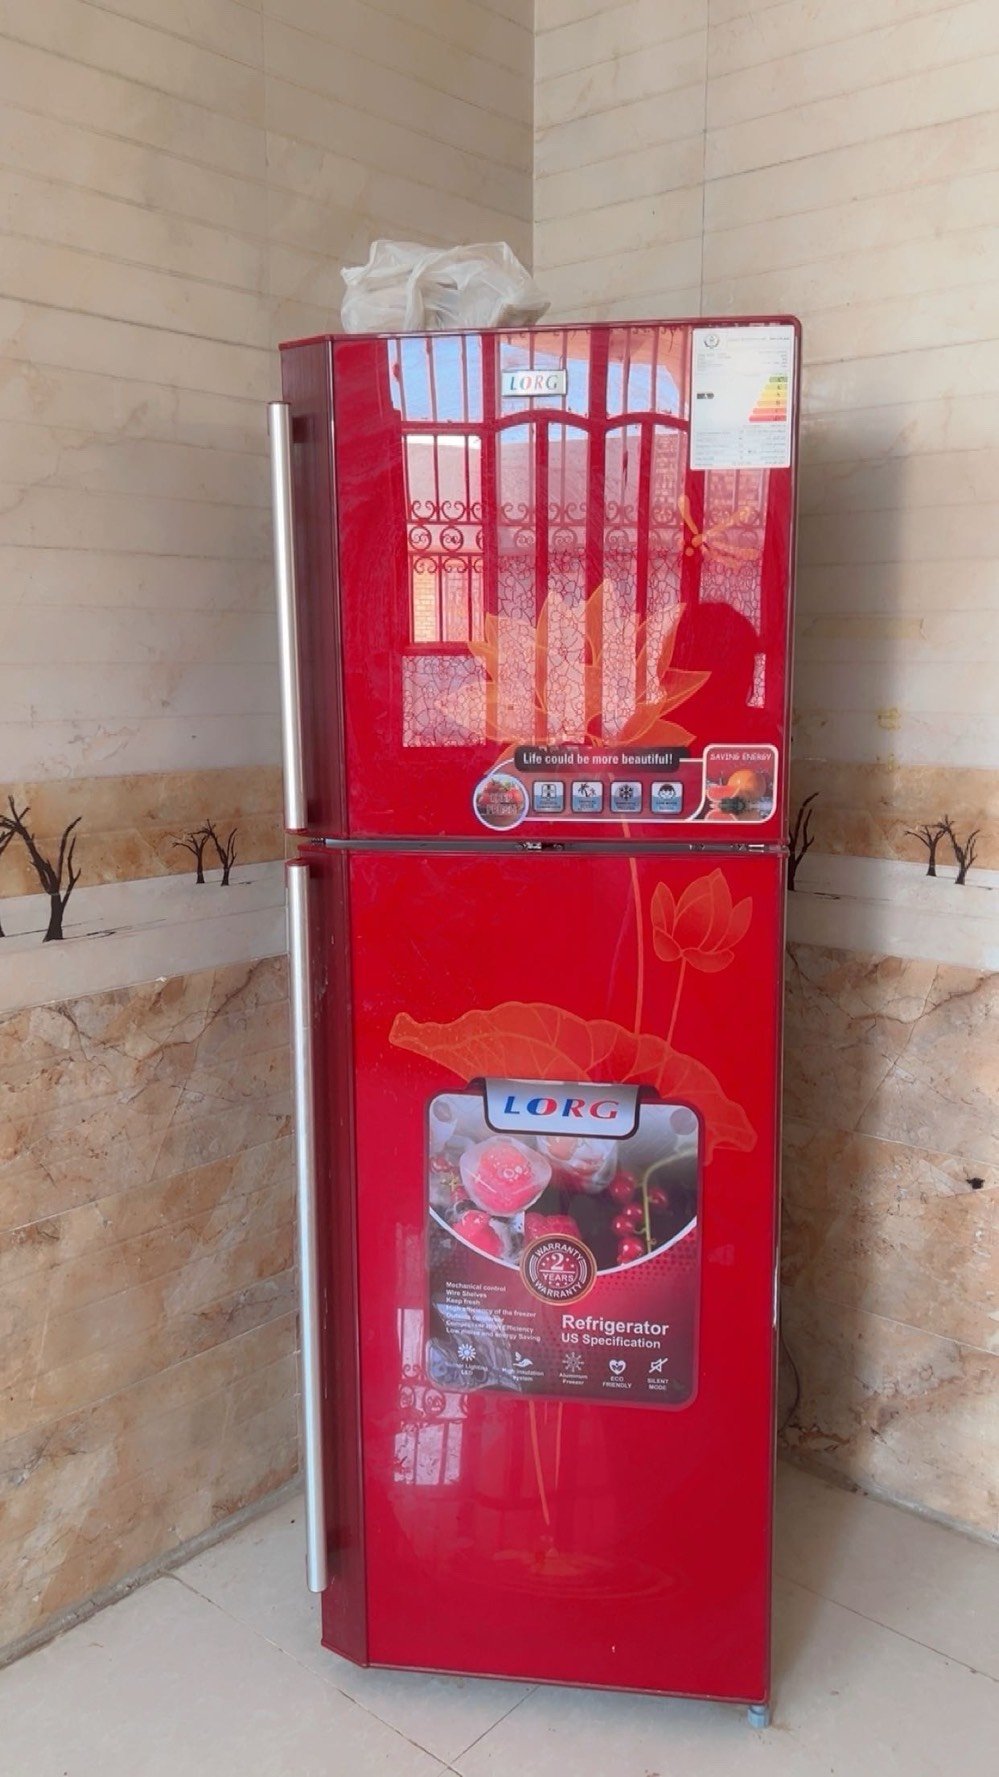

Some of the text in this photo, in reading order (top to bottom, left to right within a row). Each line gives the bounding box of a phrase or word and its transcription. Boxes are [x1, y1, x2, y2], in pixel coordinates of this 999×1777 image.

[509, 374, 559, 391] LORG
[523, 753, 673, 765] Life could be more beautiful!
[710, 752, 772, 761] SAVING ENERGY
[504, 1096, 619, 1120] LORG
[535, 1243, 583, 1261] WARRANTY
[550, 1252, 564, 1271] 2
[542, 1273, 574, 1282] YEARS
[446, 1281, 482, 1290] Mechanical
[535, 1280, 582, 1298] WARRANTY
[446, 1289, 487, 1299] Wire Shelves
[446, 1297, 462, 1305] Keep
[513, 1310, 537, 1318] freezer
[562, 1314, 669, 1336] Refrigerator
[519, 1333, 541, 1342] Saving
[561, 1332, 661, 1349] US Specification
[602, 1381, 632, 1389] FRIENDLY
